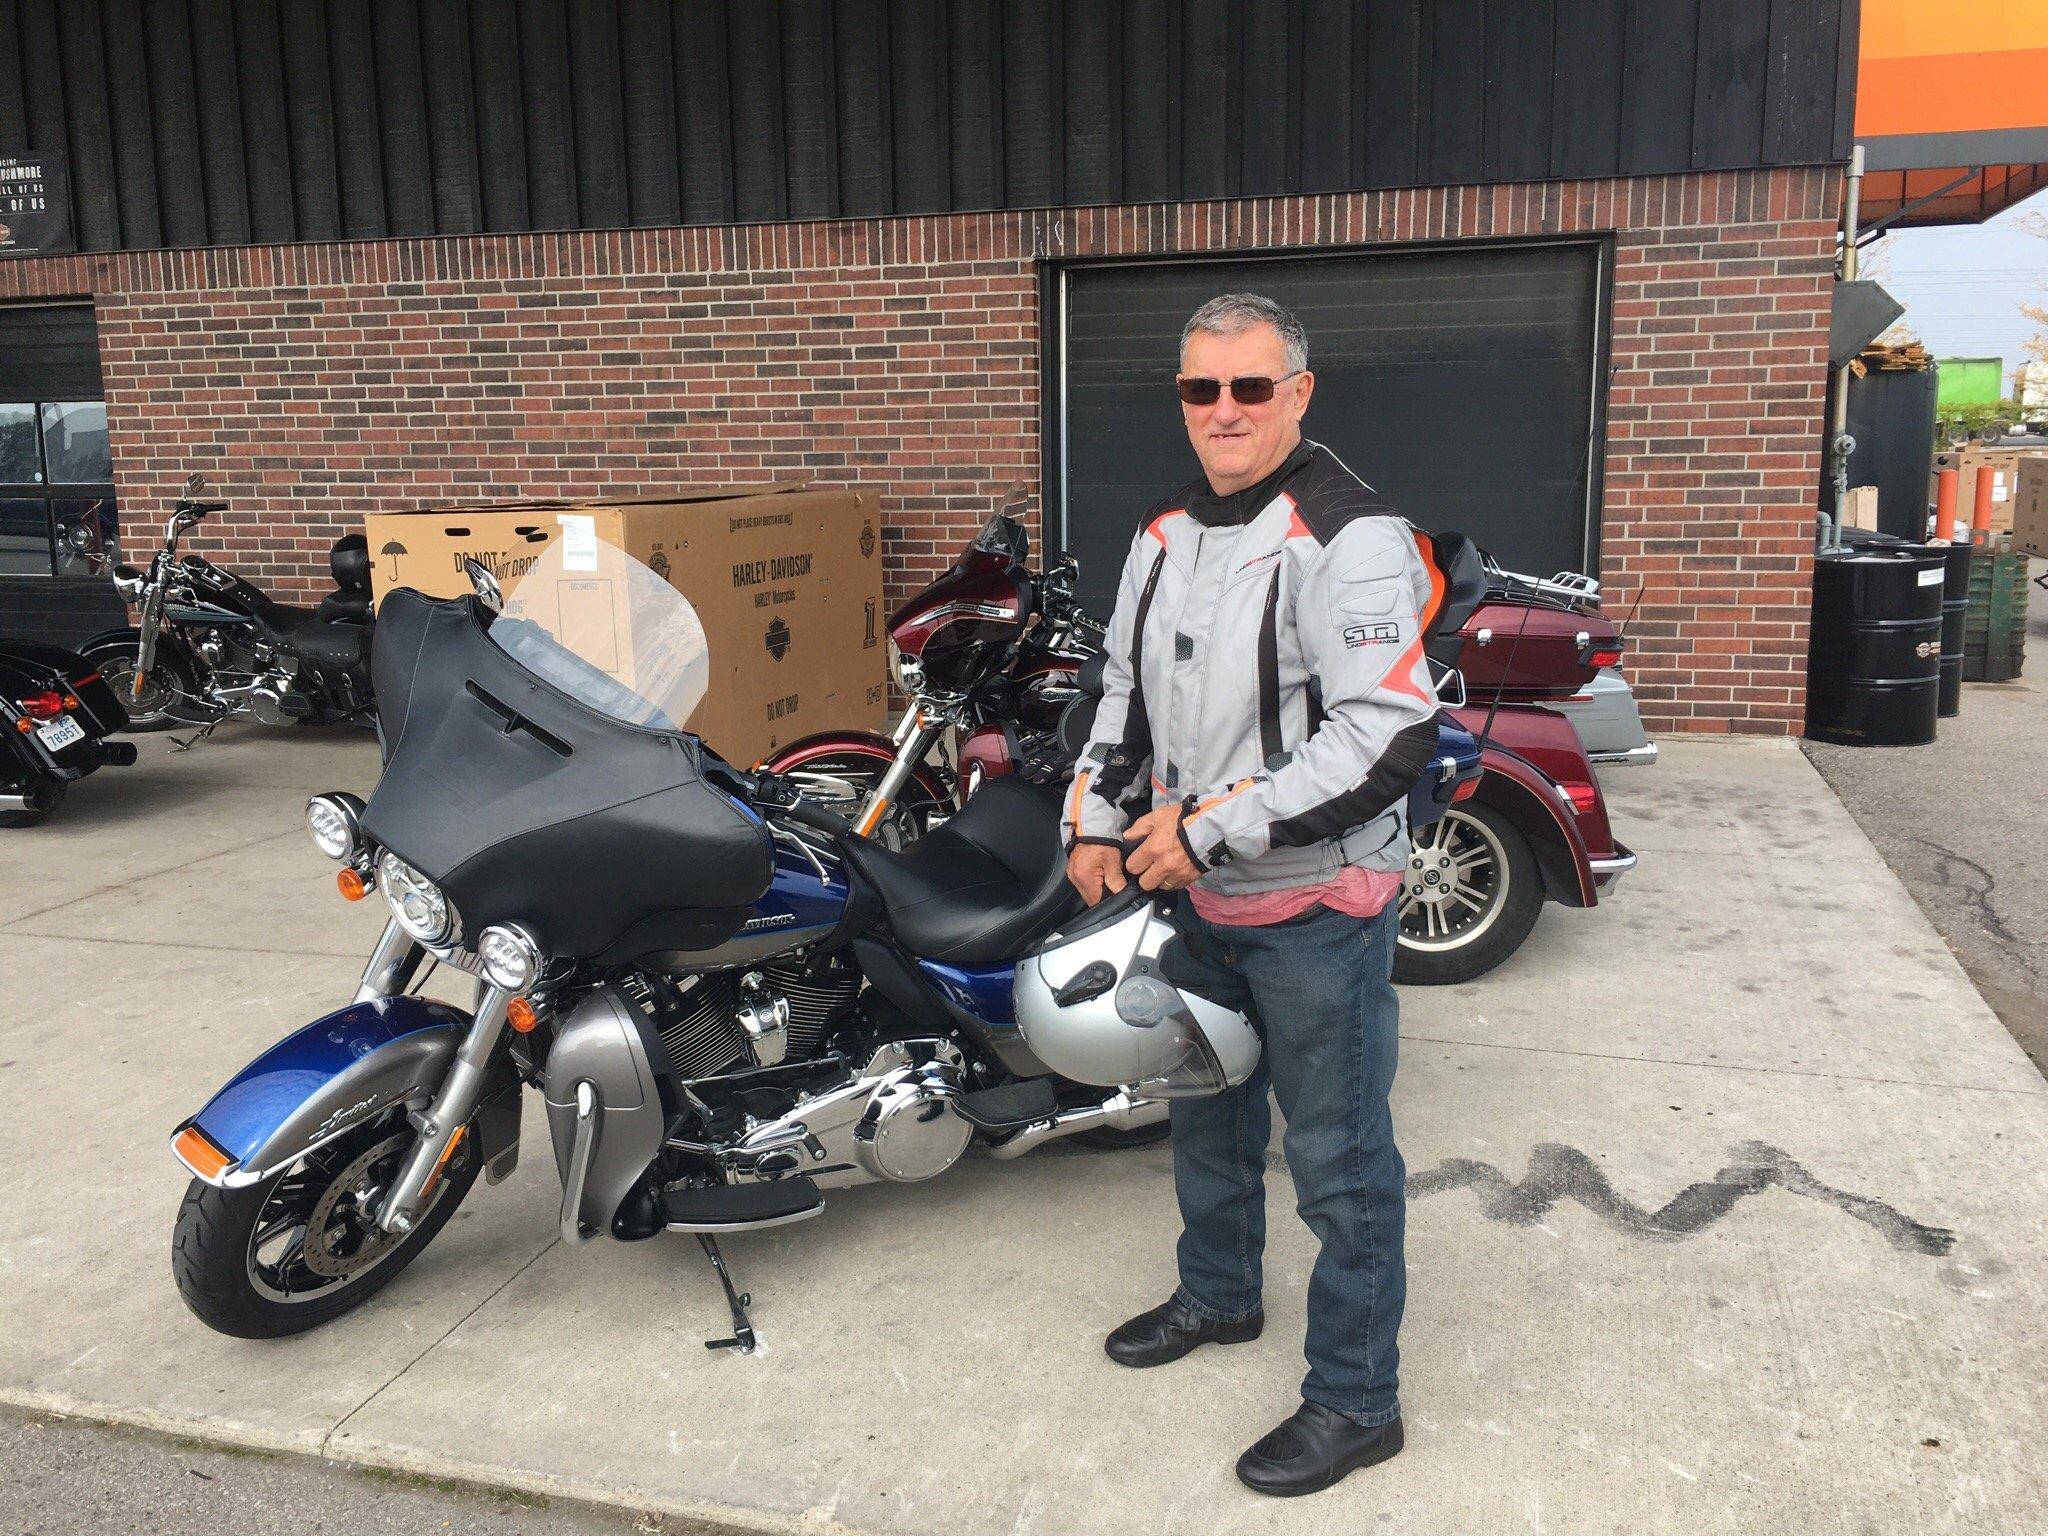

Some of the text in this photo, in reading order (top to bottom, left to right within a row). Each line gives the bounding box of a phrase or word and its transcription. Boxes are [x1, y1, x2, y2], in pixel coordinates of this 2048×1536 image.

[11, 198, 45, 212] OF US
[46, 724, 80, 747] 7895T
